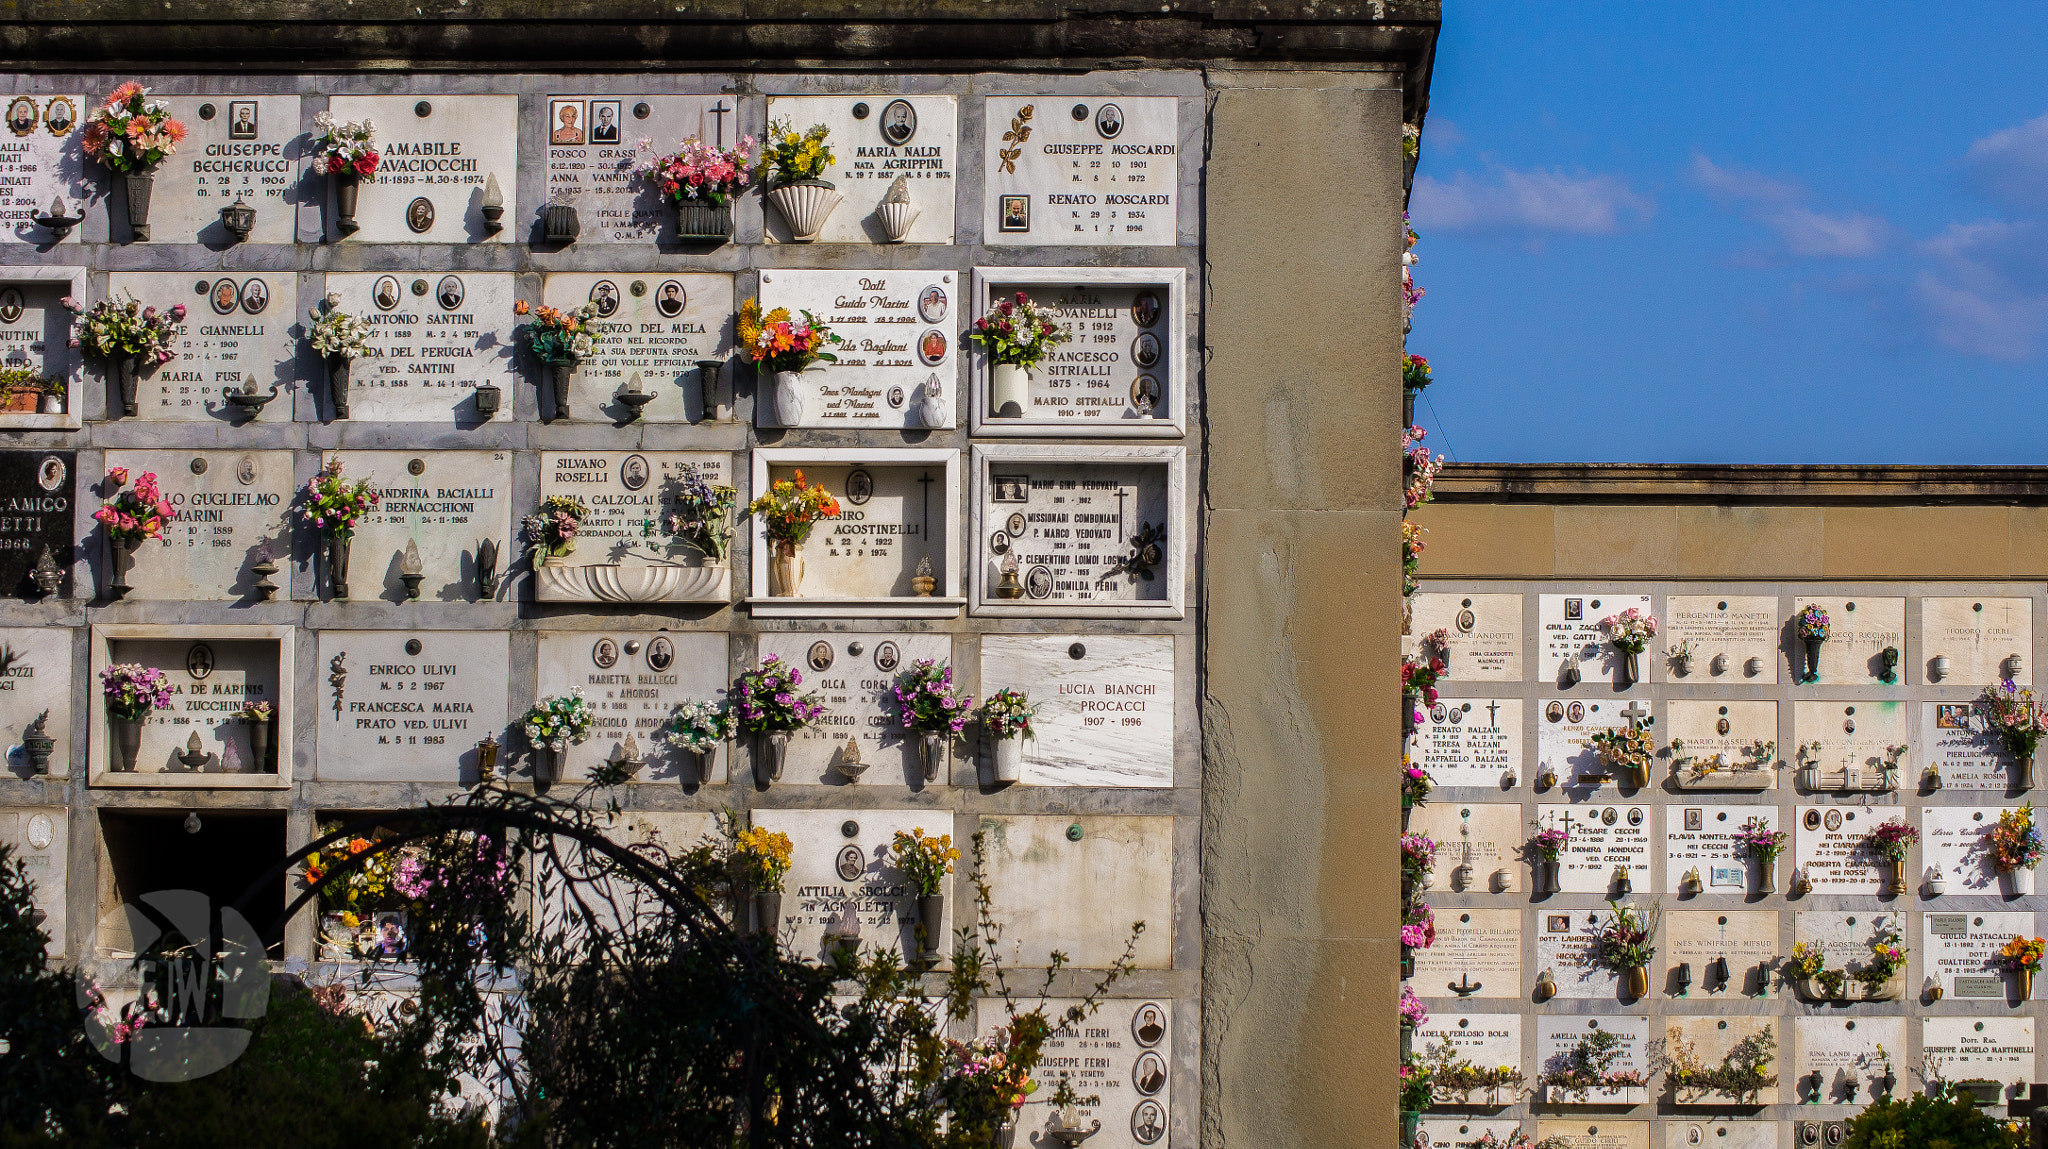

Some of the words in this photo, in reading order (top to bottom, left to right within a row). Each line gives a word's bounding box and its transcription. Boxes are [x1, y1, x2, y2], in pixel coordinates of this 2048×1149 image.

[205, 143, 281, 157] GIUSEPPE
[384, 142, 461, 156] AMABILE
[551, 149, 587, 159] FOSCO
[598, 149, 636, 159] GRASSI
[856, 146, 897, 157] MARIA
[904, 146, 941, 157] NALDI
[1043, 144, 1103, 155] GIUSEPPE
[1111, 145, 1176, 155] MOSCARDI
[193, 160, 290, 173] BECHERUCCI
[854, 162, 875, 170] NATA
[883, 159, 943, 170] AGRIPPINI
[260, 176, 286, 185] 1906
[551, 173, 579, 182] ANNA
[592, 173, 634, 182] VANNINI
[1128, 174, 1146, 182] 1972
[1048, 195, 1097, 205] RENATO
[1105, 195, 1170, 205] MOSCARDI
[601, 210, 623, 218] FIGLI
[632, 210, 663, 219] QUANTI
[1128, 211, 1145, 219] 1934
[613, 221, 658, 229] AMARONO
[834, 296, 866, 309] Guido
[870, 296, 910, 309] Marini
[366, 314, 419, 325] ANTONIO
[426, 314, 474, 325] SANTINI
[200, 325, 265, 336] GIANNELLI
[640, 323, 665, 334] DEL
[671, 323, 706, 334] MELA
[1092, 322, 1114, 331] 1912
[648, 337, 688, 345] RICORDO
[1093, 335, 1116, 343] 1995
[611, 348, 627, 356] SUA
[629, 348, 668, 356] DEFUNTA
[671, 348, 699, 356] SPOSA
[860, 339, 908, 355] Baglioni
[391, 347, 415, 358] DEL
[421, 347, 474, 358] PERUGIA
[1040, 352, 1119, 363] FRANCESCO
[601, 359, 617, 367] QUI
[621, 359, 649, 367] VOLLE
[653, 359, 698, 367] EFFIGIATA
[379, 365, 400, 374] VED.
[408, 364, 456, 374] SANTINI
[1048, 366, 1111, 376] SITRIALLI
[161, 372, 203, 382] MARIA
[215, 371, 241, 382] FUSI
[1048, 380, 1071, 388] 1875
[1087, 380, 1110, 388] 1964
[844, 399, 875, 409] Marini
[1033, 397, 1069, 406] MARIO
[1075, 397, 1125, 407] SITRIALLI
[1058, 409, 1074, 417] 1910
[556, 459, 607, 469] SILVANO
[555, 472, 609, 483] ROSELLI
[1031, 480, 1054, 490] MARIO
[1059, 480, 1076, 490] GINO
[1082, 480, 1118, 491] VEDOVATO
[436, 489, 494, 499] BACIALLI
[191, 493, 280, 506] GUGLIELMO
[591, 495, 654, 505] CALZOLAI
[385, 503, 475, 513] BERNACCHIONI
[170, 509, 223, 522] MARINI
[1027, 513, 1069, 524] MISSIONARI
[1074, 513, 1119, 524] COMBONIANI
[582, 519, 615, 527] MARITO
[213, 526, 233, 535] 1889
[834, 524, 919, 535] AGOSTINELLI
[1043, 529, 1070, 539] MARCO
[1075, 529, 1112, 539] VEDOVATO
[211, 539, 232, 547] 1968
[875, 538, 893, 546] 1922
[871, 549, 888, 557] 1974
[1026, 555, 1071, 565] CLEMENTINO
[1055, 581, 1090, 591] ROMILDA
[1095, 581, 1118, 591] PERIN
[1731, 612, 1769, 620] MANETTI
[369, 665, 416, 676] ENRICO
[423, 665, 457, 675] ULIVI
[588, 675, 631, 685] MARIETTA
[212, 684, 264, 695] MARINIS
[423, 682, 445, 691] 1967
[1059, 684, 1095, 695] LUCIA
[1105, 684, 1156, 695] BIANCHI
[619, 689, 659, 699] AMOROSI
[349, 702, 425, 713] FRANCESCA
[432, 702, 474, 713] MARIA
[1081, 701, 1146, 712] PROCACCI
[356, 719, 396, 729] PRATO
[403, 720, 429, 730] VED.
[432, 719, 468, 729] ULIVI
[1084, 717, 1105, 726] 1907
[1121, 717, 1142, 727] 1996
[1432, 726, 1462, 734] RENATO
[1467, 726, 1501, 734] BALZANI
[423, 736, 445, 745] 1983
[1466, 741, 1501, 749] BALZANI
[1425, 755, 1470, 763] RAFFAELLO
[1668, 833, 1696, 841] FLAVIA
[1603, 855, 1631, 863] CECCHI
[796, 886, 846, 897] ATTILIA
[858, 886, 905, 897] SBOLCI
[1085, 1028, 1110, 1038] FERRI
[1991, 1046, 2034, 1054] MARTINELLI
[1037, 1057, 1080, 1068] GIUSEPPE
[1084, 1058, 1110, 1068] FERRI
